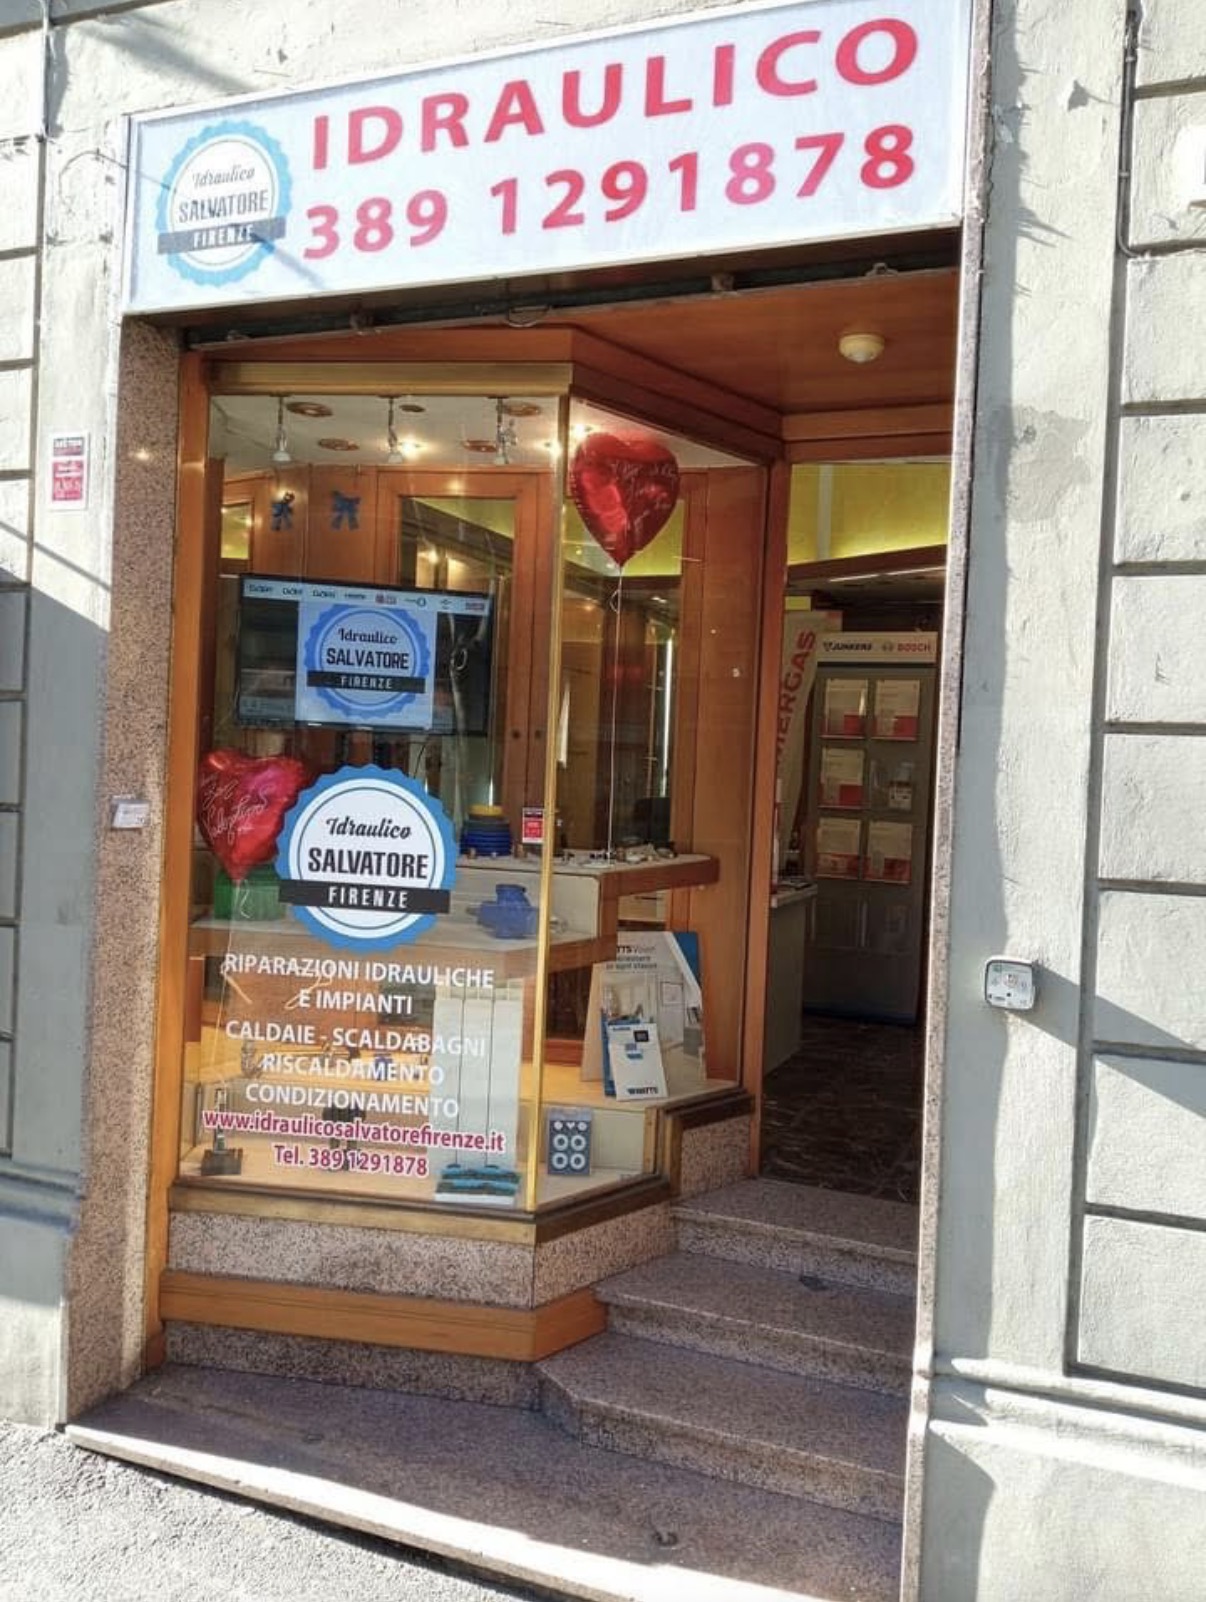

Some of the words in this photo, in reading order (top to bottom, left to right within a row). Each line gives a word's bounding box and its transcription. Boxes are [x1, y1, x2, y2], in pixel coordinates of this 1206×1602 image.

[312, 17, 919, 171] IDRAULICO
[191, 164, 255, 188] Idraulico
[302, 188, 449, 260] 389
[490, 123, 915, 236] 1291878
[178, 189, 268, 222] SALVATORE
[193, 223, 253, 248] FIRENZE
[337, 627, 398, 646] Idraulico
[897, 642, 931, 652] BOSCH
[326, 647, 410, 670] SALVATORE
[340, 676, 394, 690] FIRENZE
[325, 815, 412, 840] Idraulico
[307, 847, 429, 880] SALVATORE
[328, 885, 409, 909] FIRENZE
[224, 953, 360, 980] RIPARAZIONI
[365, 962, 495, 990] IDRAULICHE
[299, 992, 311, 1008] E
[316, 992, 413, 1015] IMPIANTI
[225, 1020, 316, 1045] CALDAIE
[332, 1028, 485, 1056] SCALDABAGNI
[262, 1055, 445, 1086] RISCALDAMENTO
[245, 1083, 460, 1119] CONDIZIONAMENTO
[203, 1109, 505, 1152] www.idraulicosalvatorefirenze.it
[274, 1145, 303, 1166] Tel.
[309, 1149, 343, 1169] 389
[348, 1152, 429, 1177] 1291878
